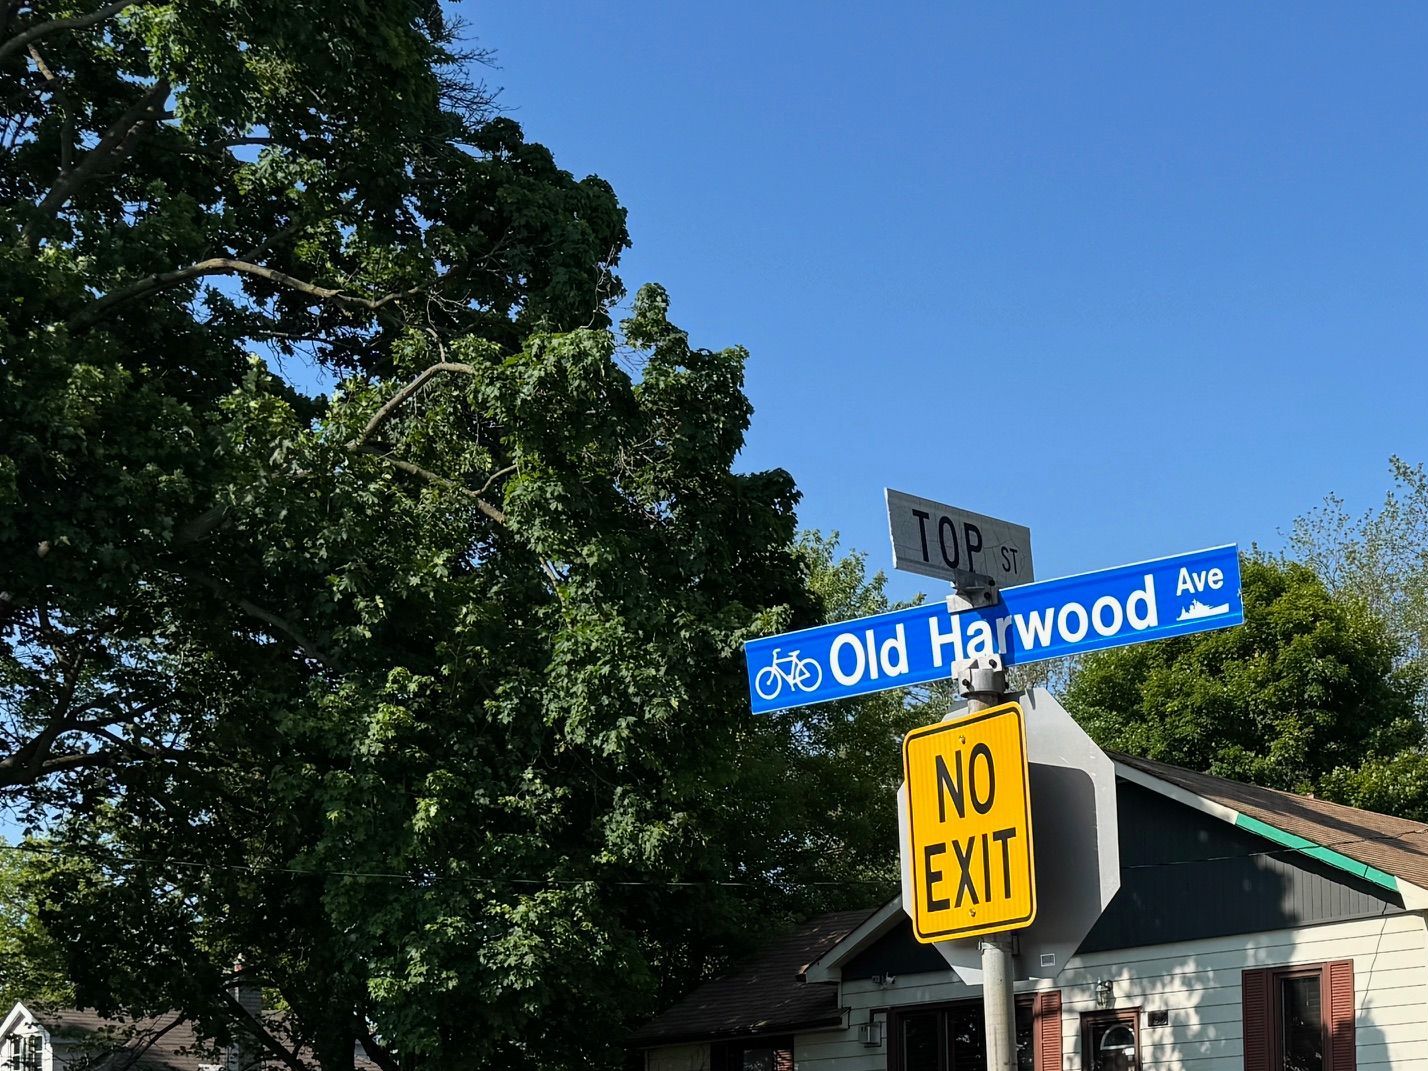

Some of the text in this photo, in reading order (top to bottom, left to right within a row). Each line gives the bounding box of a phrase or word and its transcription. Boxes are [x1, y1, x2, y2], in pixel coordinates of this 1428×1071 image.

[912, 509, 1018, 575] TOP ST
[828, 567, 1225, 686] Old Harwood Ave
[935, 742, 996, 824] NO
[924, 827, 1017, 913] EXIT
